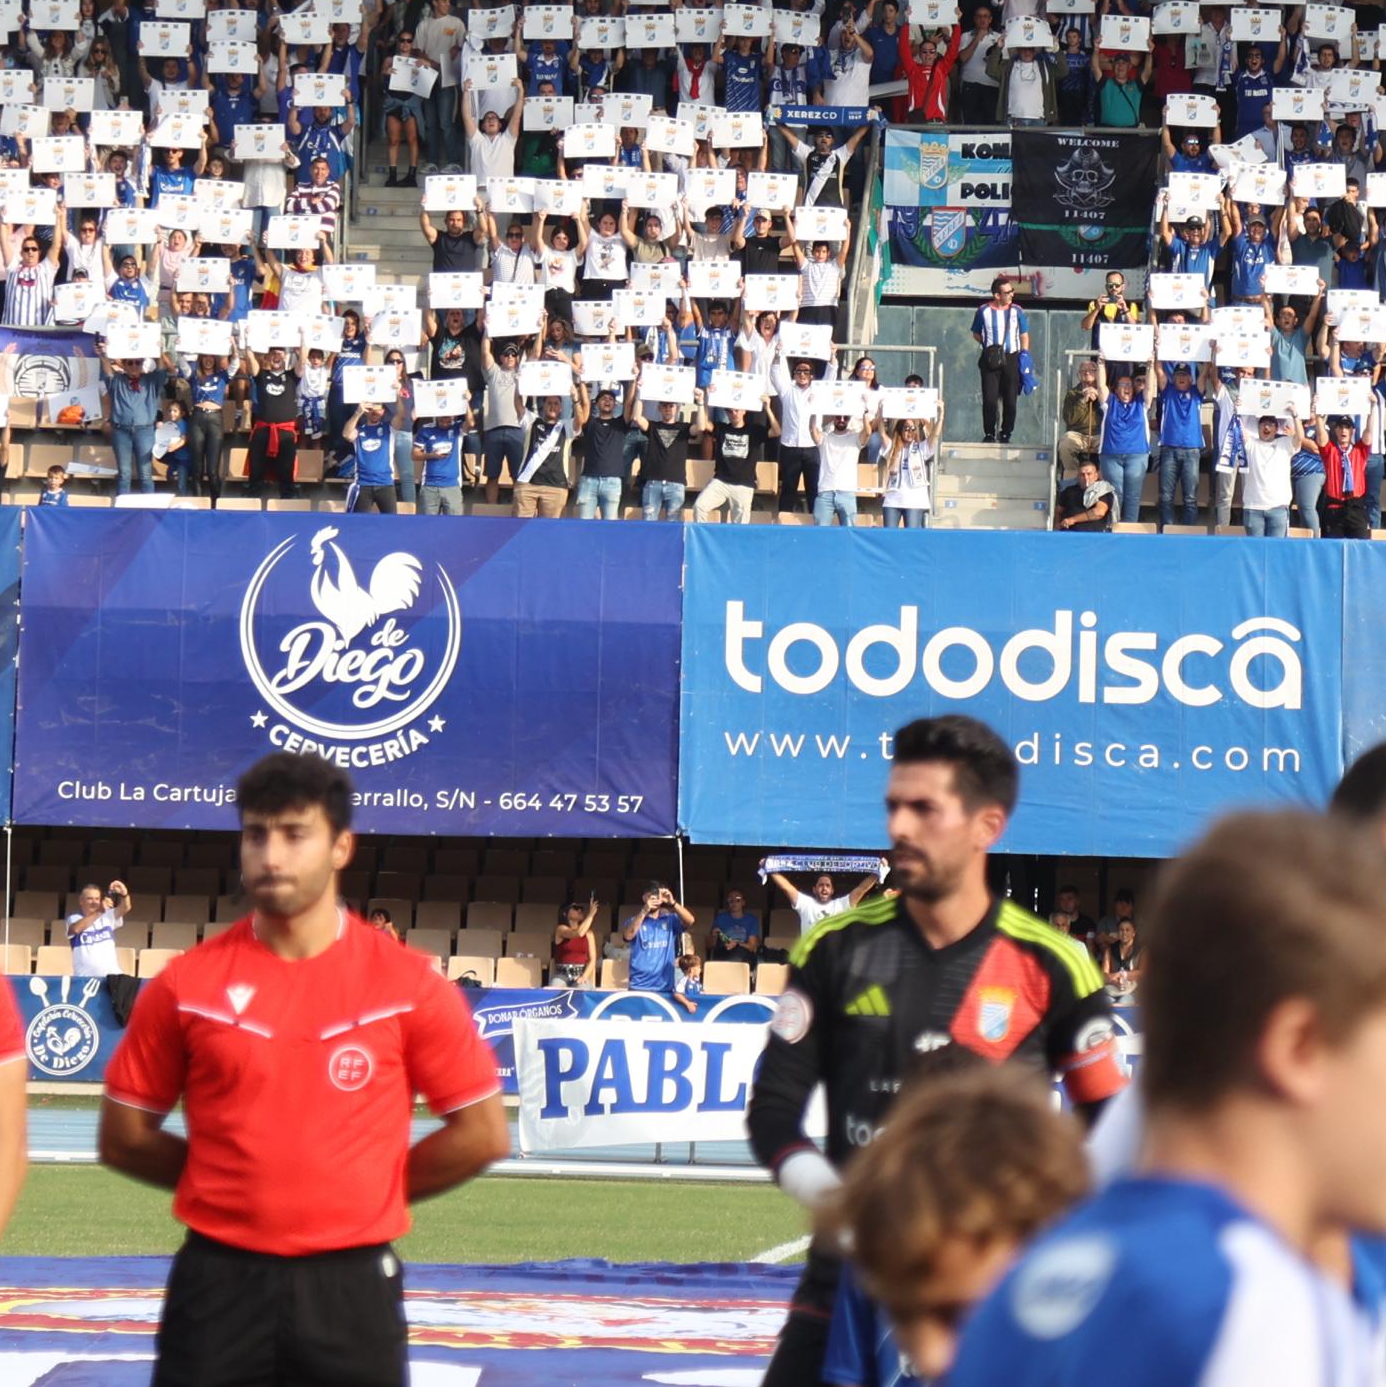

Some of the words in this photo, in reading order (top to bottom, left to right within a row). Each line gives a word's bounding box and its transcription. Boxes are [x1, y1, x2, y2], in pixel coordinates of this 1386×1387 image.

[961, 143, 1013, 160] KOM
[1058, 138, 1121, 149] WELCOME
[1065, 209, 1106, 220] 11407
[1072, 254, 1110, 264] 11407
[372, 618, 409, 648] de
[270, 622, 426, 708] Diego
[57, 780, 113, 801] Club
[120, 782, 145, 802] La
[152, 781, 238, 807] Cartuja
[350, 790, 430, 811] errallo,
[435, 792, 476, 810] S/N
[498, 792, 543, 812] 664
[548, 793, 578, 813] 47
[583, 794, 612, 813] 53
[616, 794, 644, 814] 57
[487, 1010, 518, 1024] DONAR
[519, 1004, 563, 1019] ÓRGANOS
[33, 1044, 49, 1063] De
[53, 1045, 90, 1068] Diego
[340, 1056, 366, 1070] RF
[338, 1069, 363, 1082] EF
[538, 1037, 762, 1120] PABL
